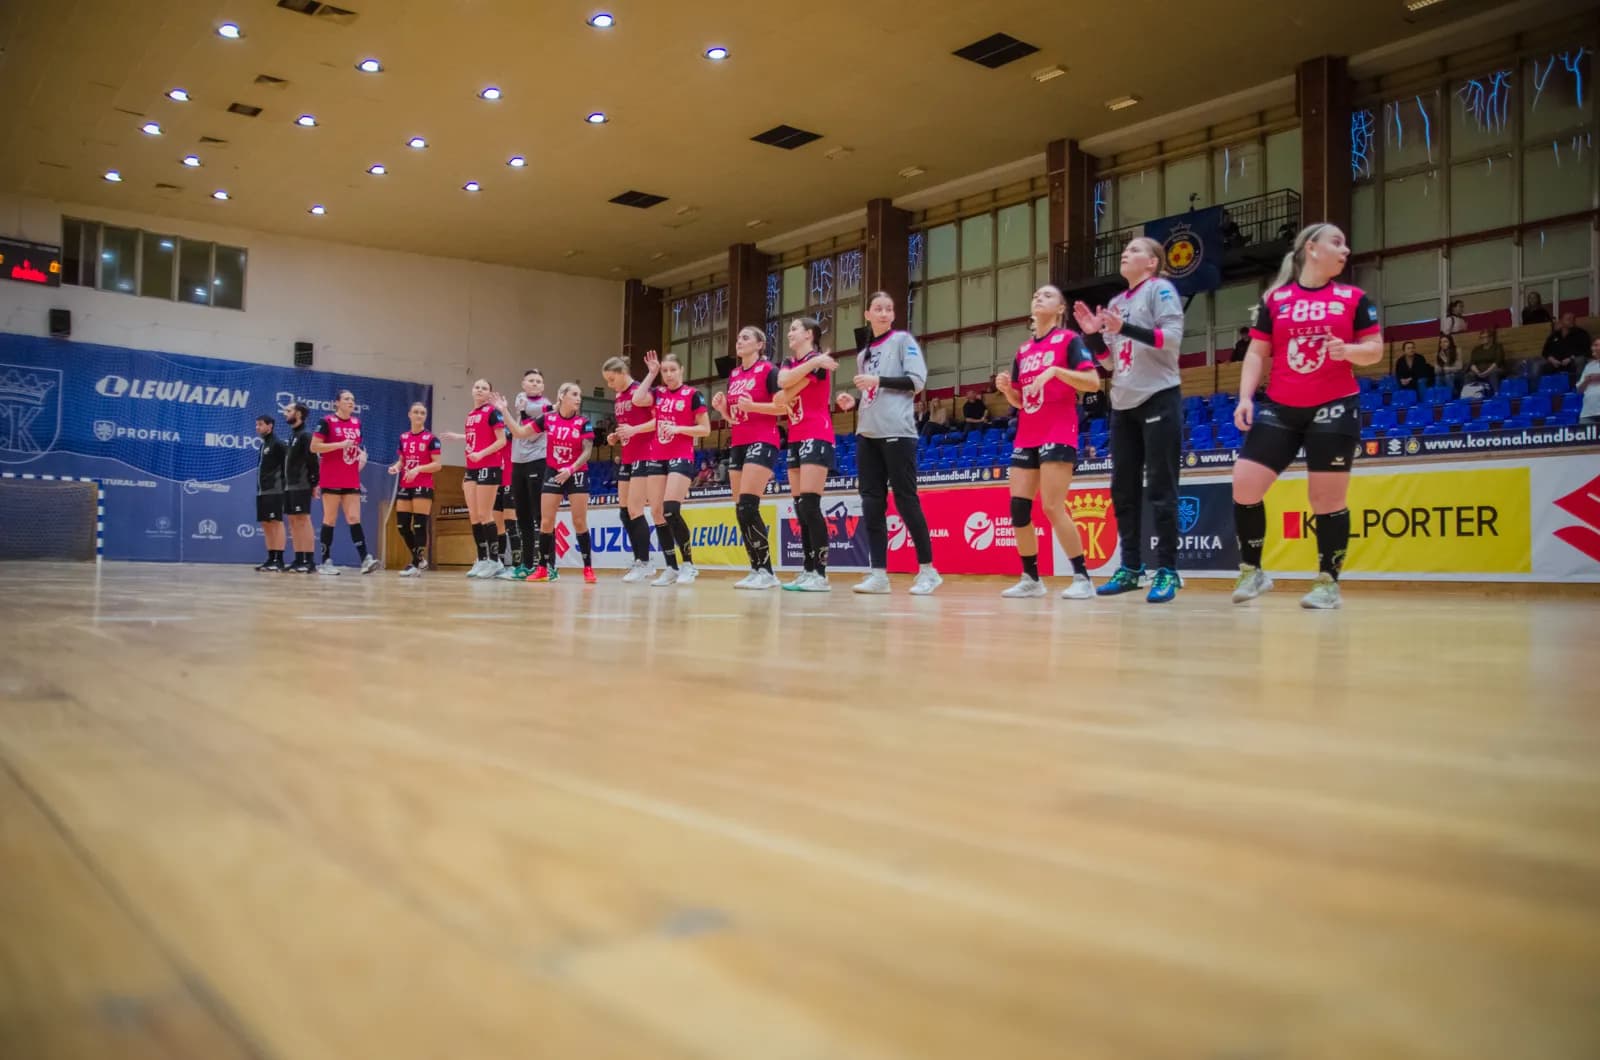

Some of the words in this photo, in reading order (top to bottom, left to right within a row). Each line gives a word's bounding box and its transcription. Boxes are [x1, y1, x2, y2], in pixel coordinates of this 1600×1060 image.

[1292, 299, 1326, 322] 88
[129, 379, 250, 409] LEWIATAN
[117, 427, 181, 442] PROFIKA
[215, 434, 264, 449] KOLPO
[557, 426, 569, 440] 17
[1303, 505, 1499, 539] KPORTER
